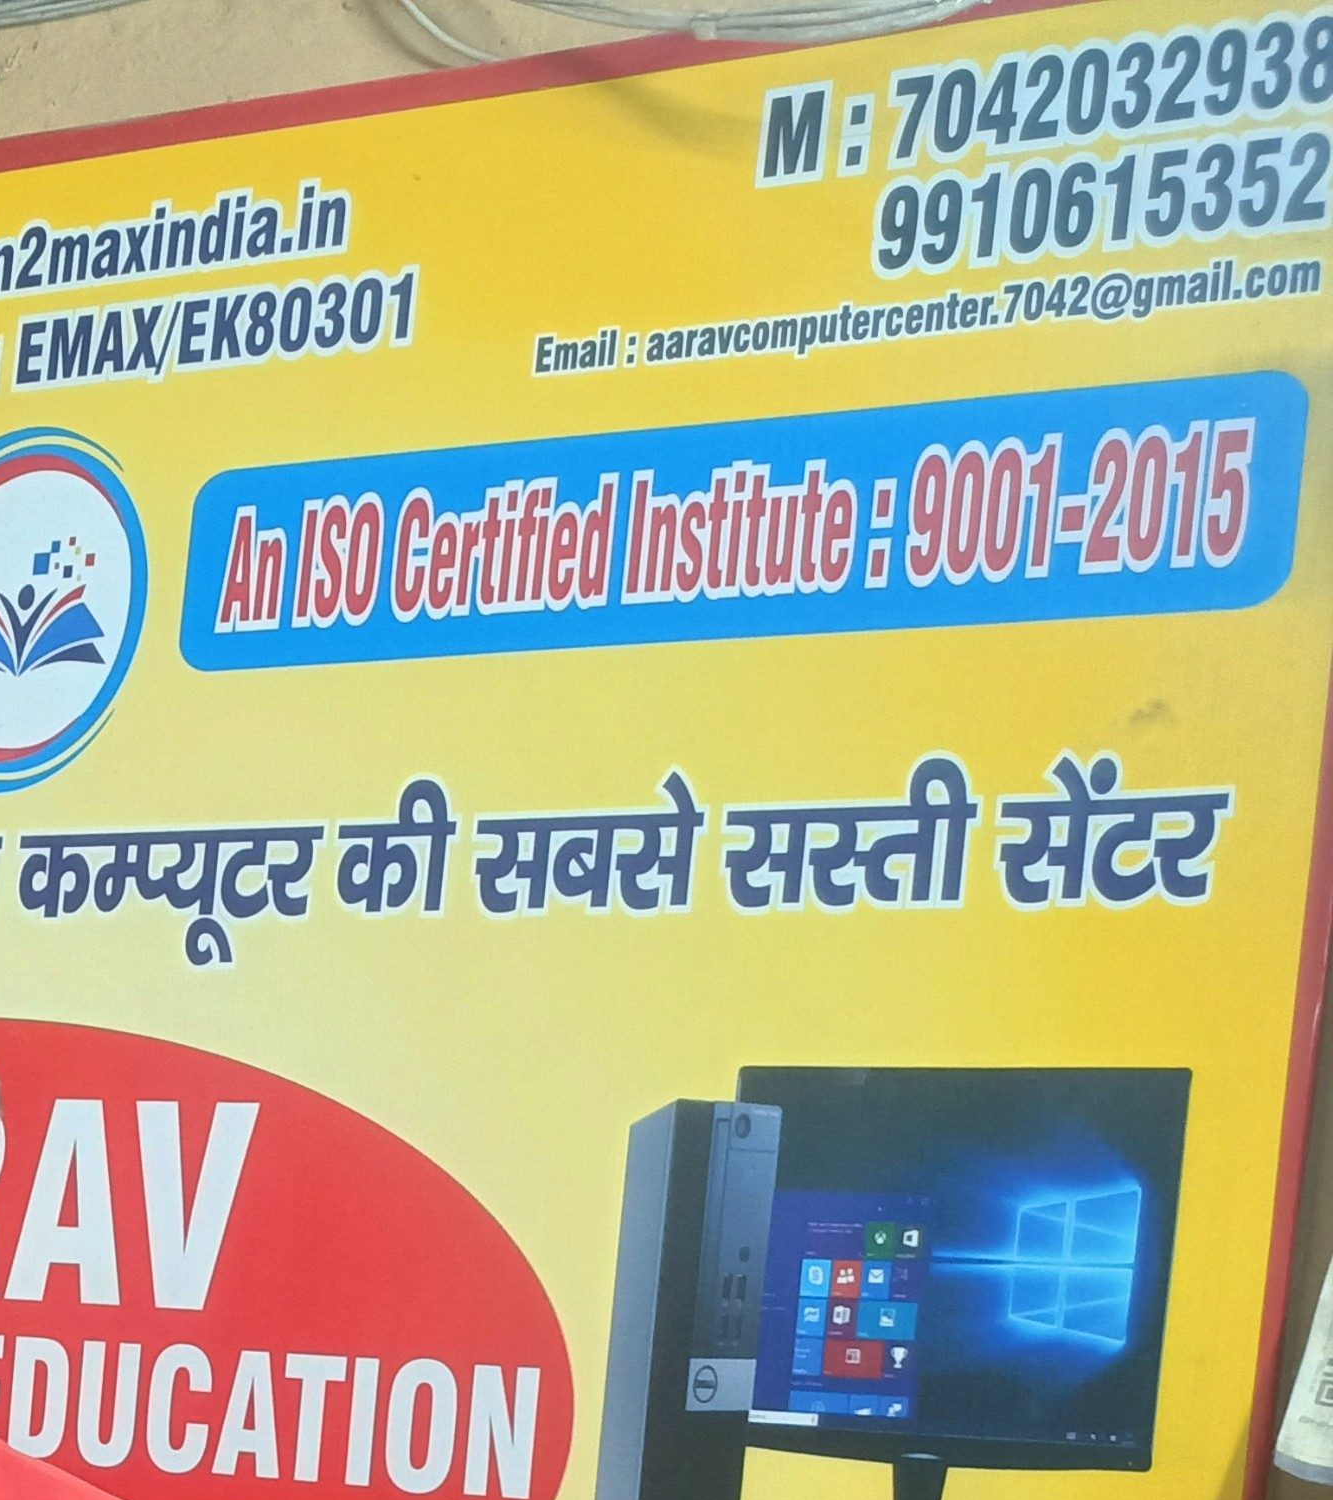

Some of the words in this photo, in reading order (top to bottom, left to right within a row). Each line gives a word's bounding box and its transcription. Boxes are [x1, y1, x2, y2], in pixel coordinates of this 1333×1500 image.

[765, 96, 820, 178] M
[847, 103, 867, 166] :
[893, 21, 1333, 160] 7042032938
[879, 133, 1328, 268] 9910615352
[16, 273, 414, 386] EMAX/EK80301
[536, 332, 617, 372] Email
[647, 259, 1321, 363] aaravcomputercenter.7042@gmail.com
[222, 514, 284, 623] An
[297, 497, 379, 619] ISO
[395, 484, 613, 612] Certified
[626, 468, 852, 594] Institute
[870, 489, 890, 577] :
[907, 428, 1248, 575] 9001-2015
[19, 825, 324, 963] कम्प्यूटर
[337, 780, 455, 912] की
[474, 770, 704, 909] सबसे
[725, 758, 979, 903] सस्ती
[1001, 754, 1228, 901] सेंटर
